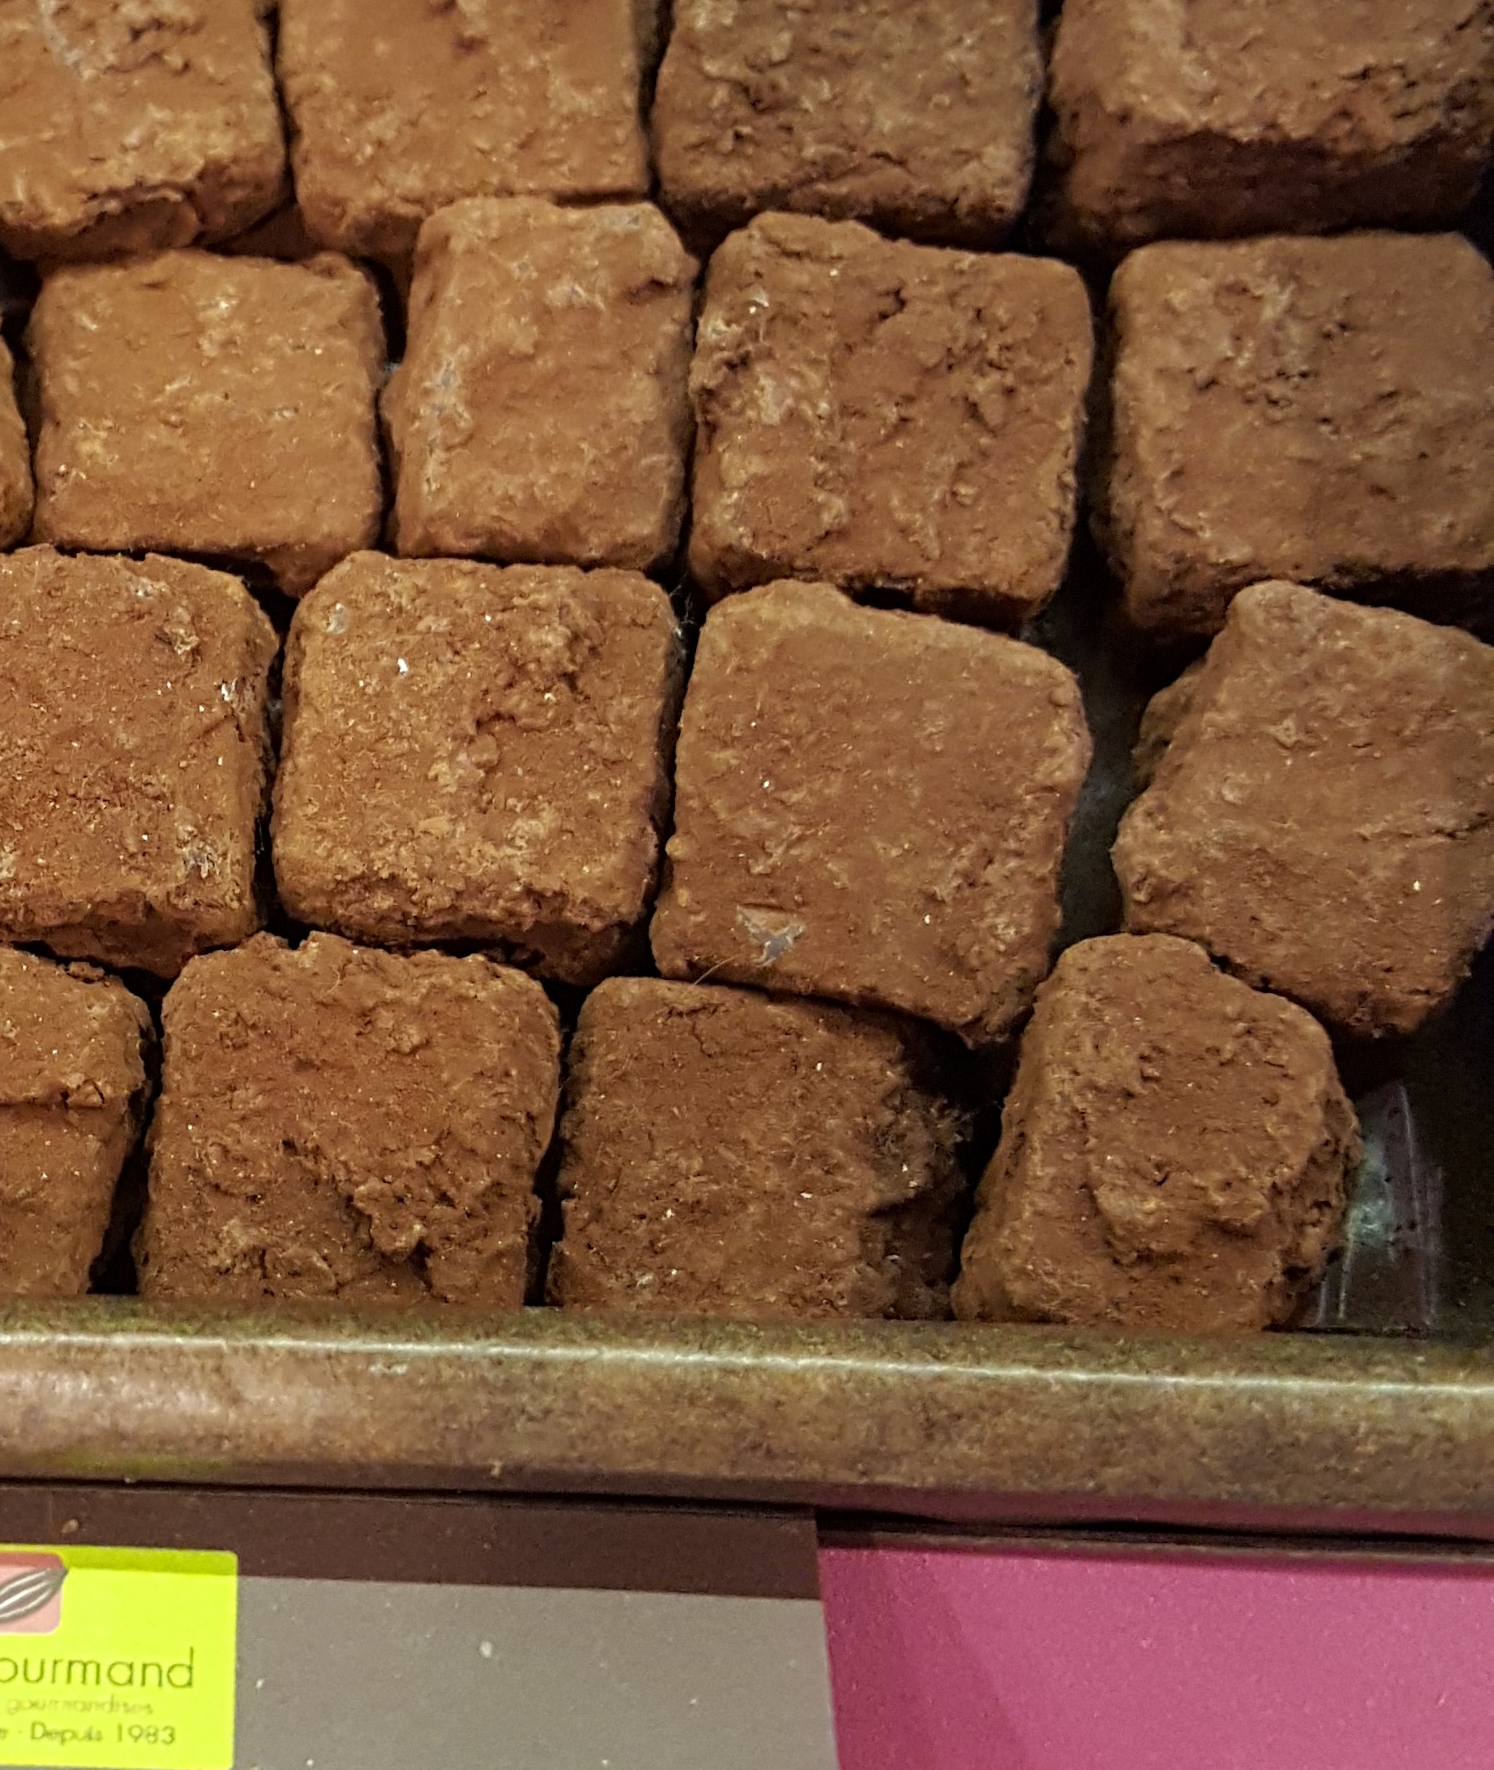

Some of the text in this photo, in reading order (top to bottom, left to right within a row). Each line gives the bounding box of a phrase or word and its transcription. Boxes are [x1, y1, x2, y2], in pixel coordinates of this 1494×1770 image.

[6, 1693, 155, 1716] gourmandises
[30, 1720, 104, 1746] Depuis
[117, 1723, 178, 1745] 1983
